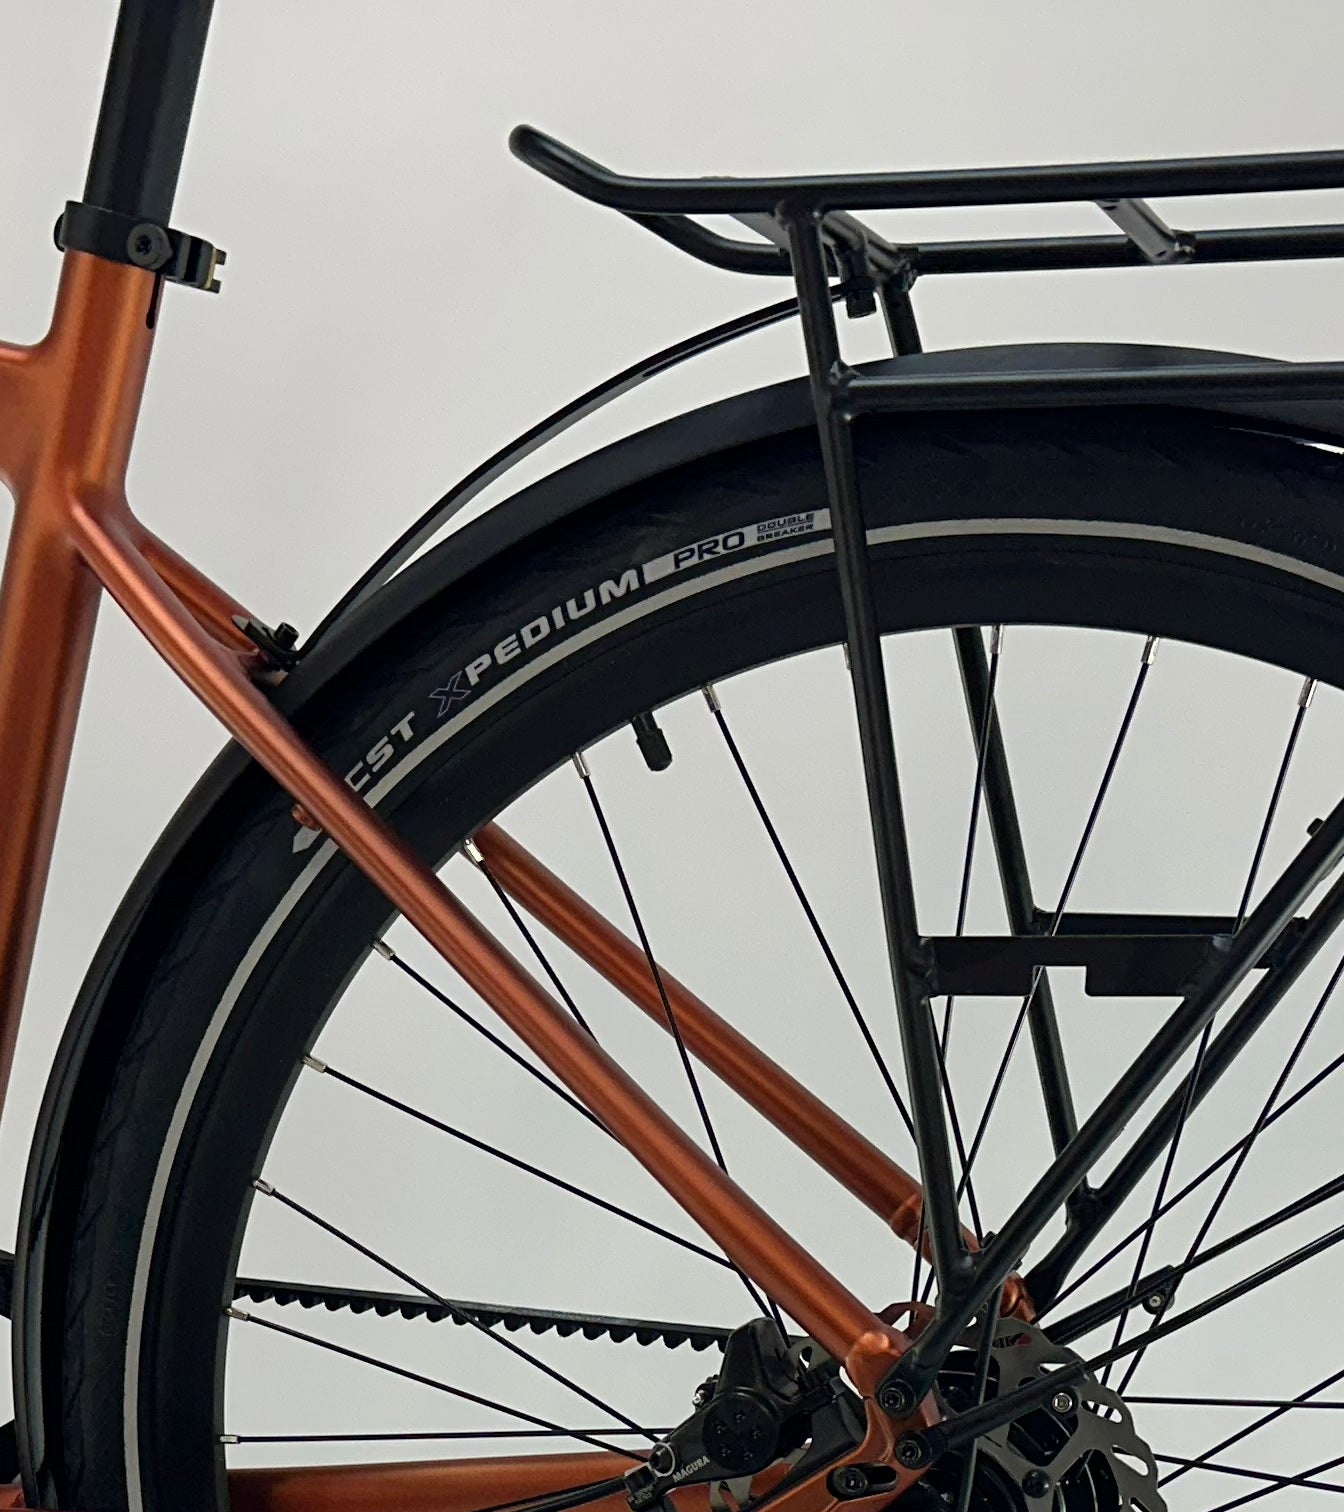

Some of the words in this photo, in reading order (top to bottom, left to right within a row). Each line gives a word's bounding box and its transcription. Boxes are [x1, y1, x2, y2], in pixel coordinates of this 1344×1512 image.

[757, 512, 815, 533] DOUBLE
[757, 524, 815, 542] BREAKER
[344, 711, 416, 791] CST
[428, 568, 640, 718] XPEDIUM
[673, 531, 746, 570] PRO
[672, 1455, 711, 1483] MAGURA
